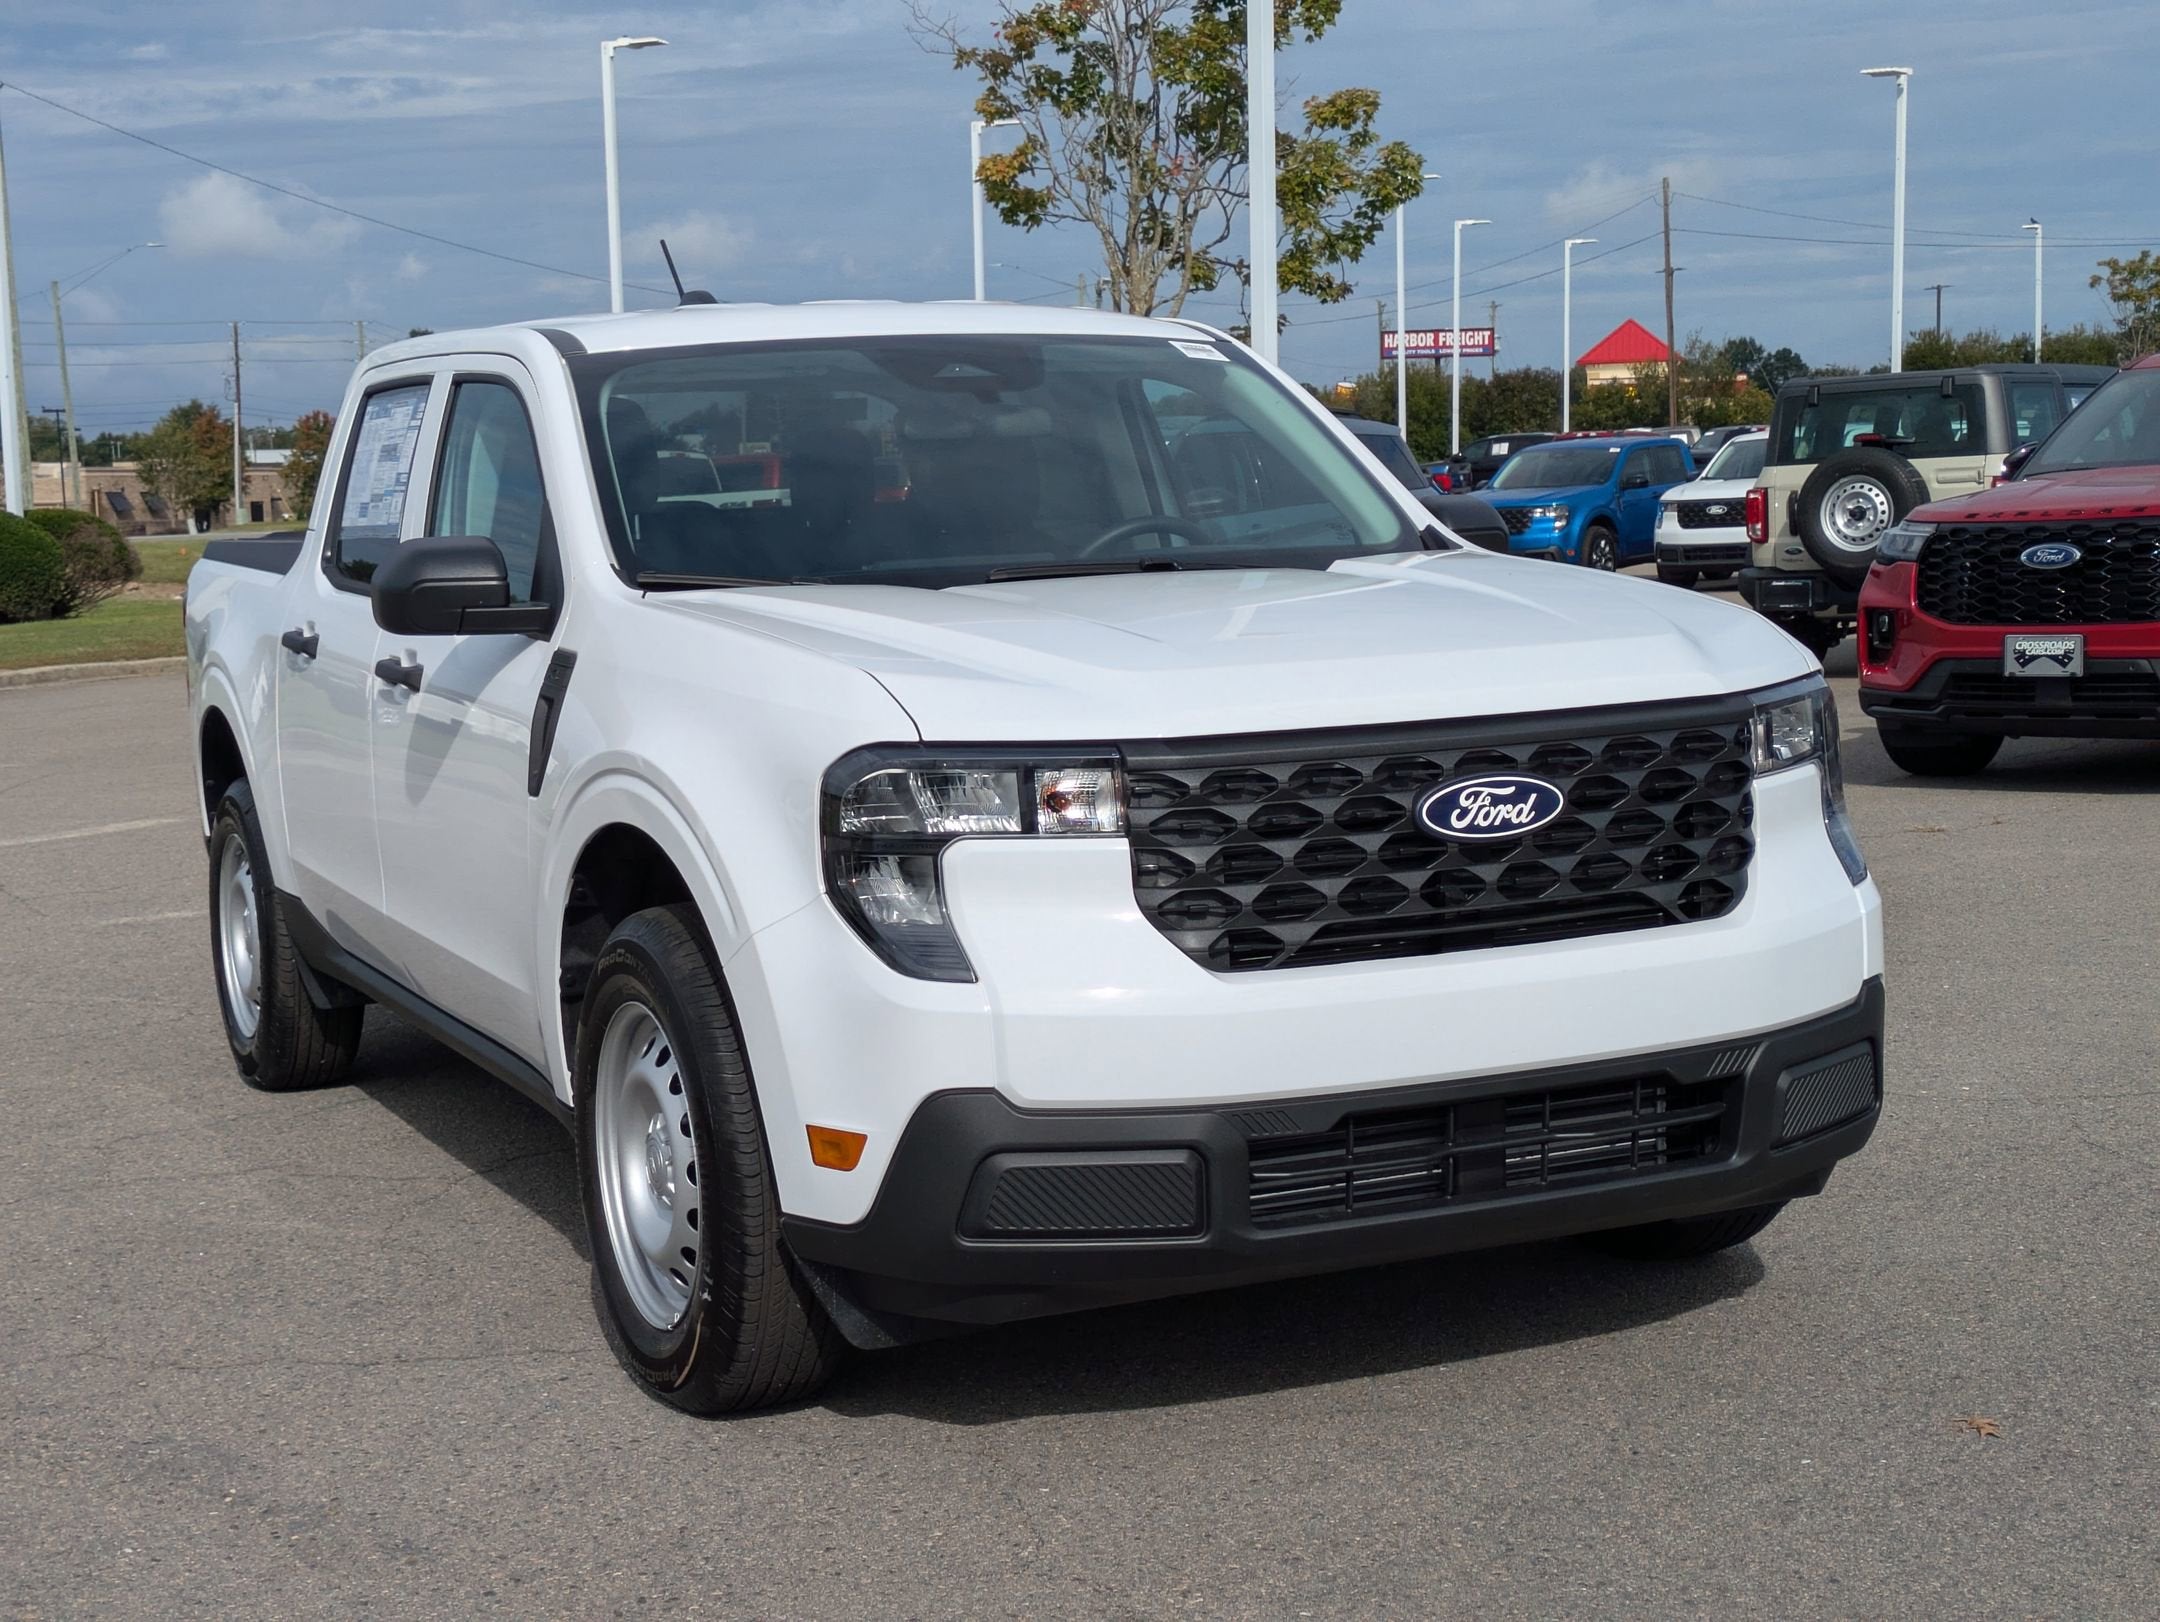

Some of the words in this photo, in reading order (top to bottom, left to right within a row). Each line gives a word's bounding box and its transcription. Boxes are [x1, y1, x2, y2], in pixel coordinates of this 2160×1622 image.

[2033, 549, 2066, 563] Ford
[2015, 641, 2075, 650] CROSSROADS
[1450, 786, 1538, 829] Ford
